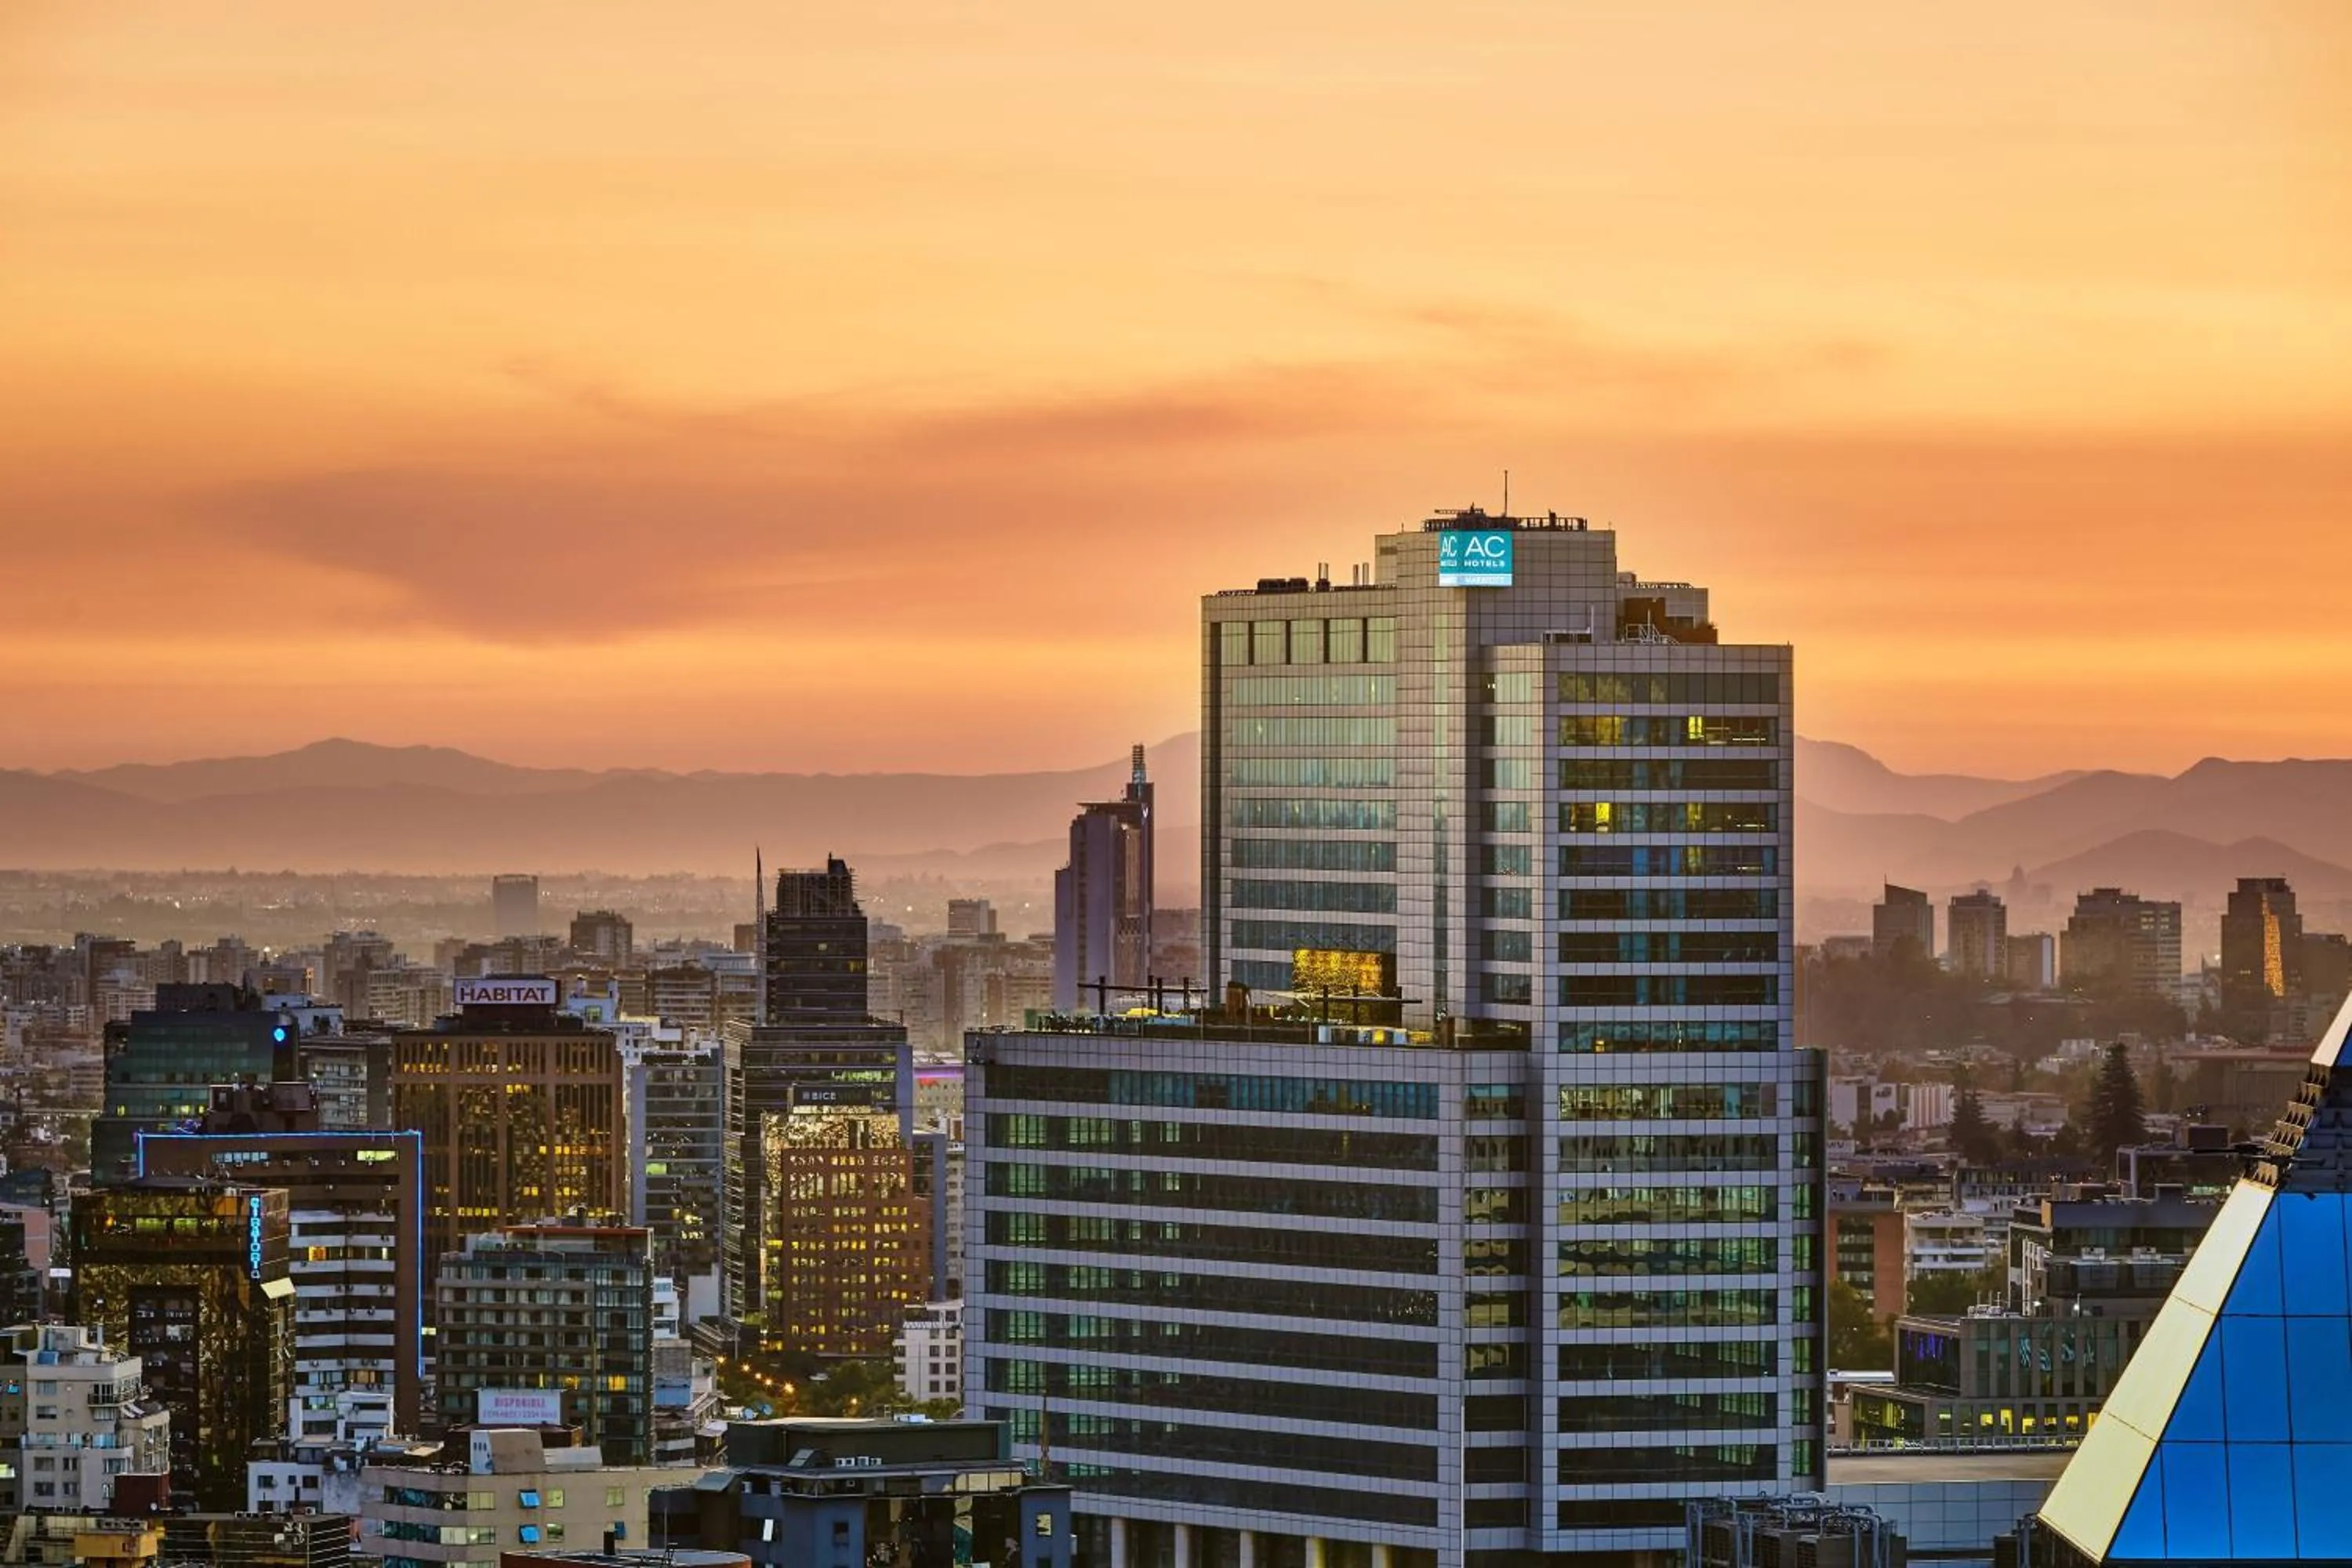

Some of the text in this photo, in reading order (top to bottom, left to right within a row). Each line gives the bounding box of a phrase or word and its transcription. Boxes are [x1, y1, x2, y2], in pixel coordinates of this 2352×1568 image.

[1440, 535, 1457, 557] AC
[1464, 535, 1505, 557] AC
[460, 987, 550, 1001] HABITAT
